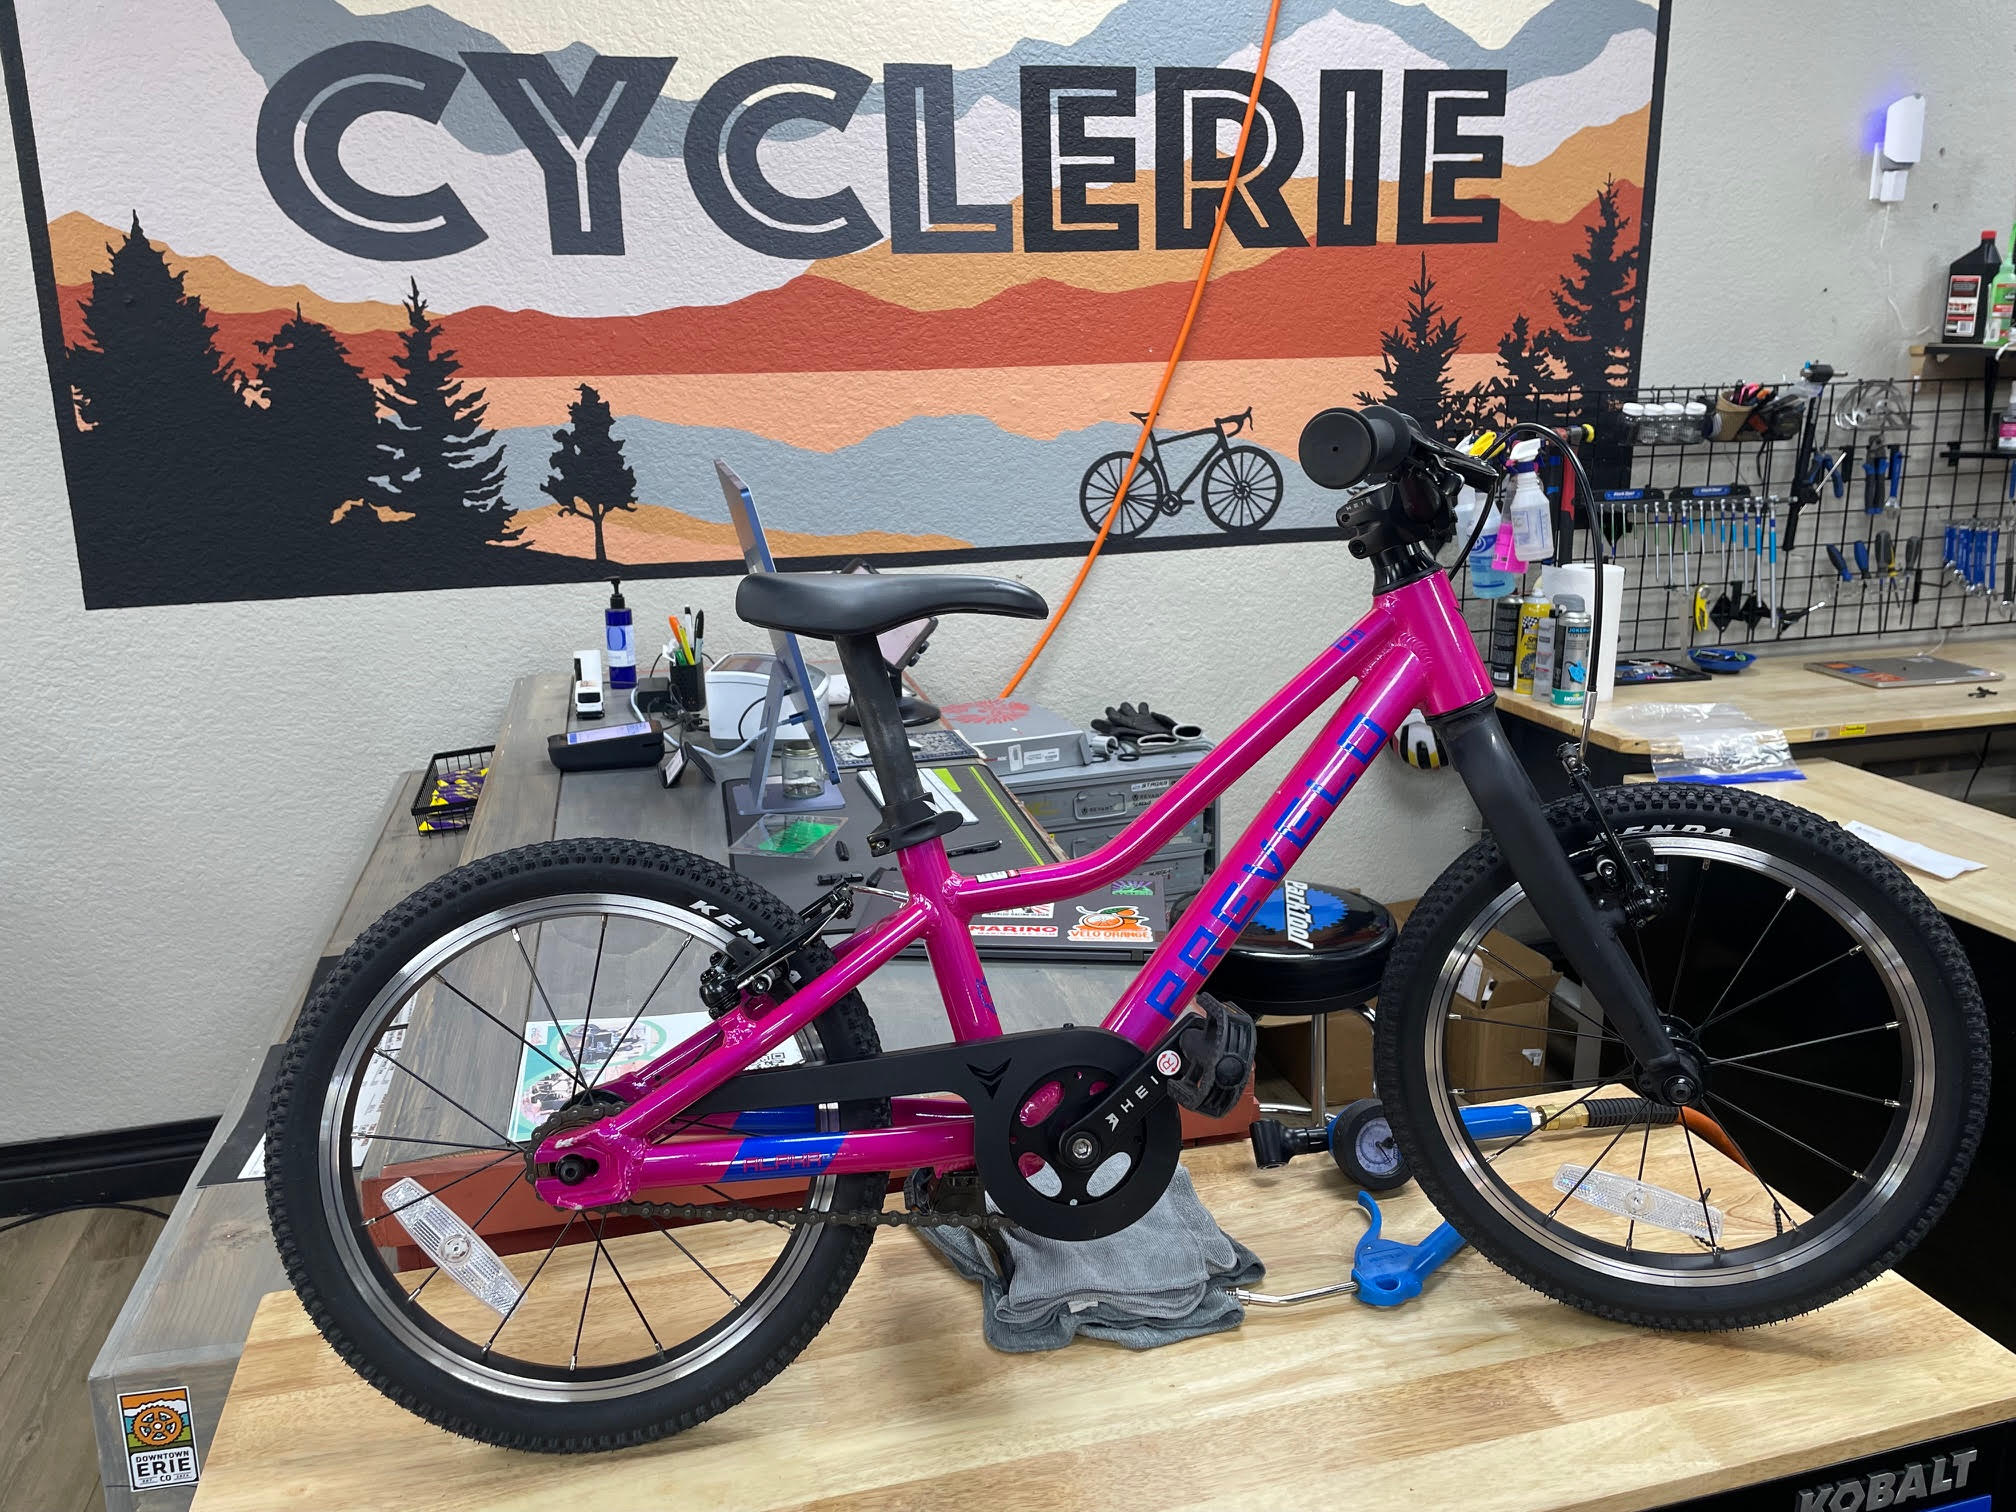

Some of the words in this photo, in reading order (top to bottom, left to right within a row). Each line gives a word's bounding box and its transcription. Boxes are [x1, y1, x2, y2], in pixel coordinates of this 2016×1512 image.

[257, 40, 1507, 260] CYCLERIE
[1146, 712, 1388, 1021] PREVELO
[969, 925, 1057, 933] MARINO
[743, 1151, 822, 1173] ALPHA
[135, 1450, 190, 1463] DOWNTOWN
[136, 1457, 192, 1478] ERIE
[159, 1474, 172, 1482] CO
